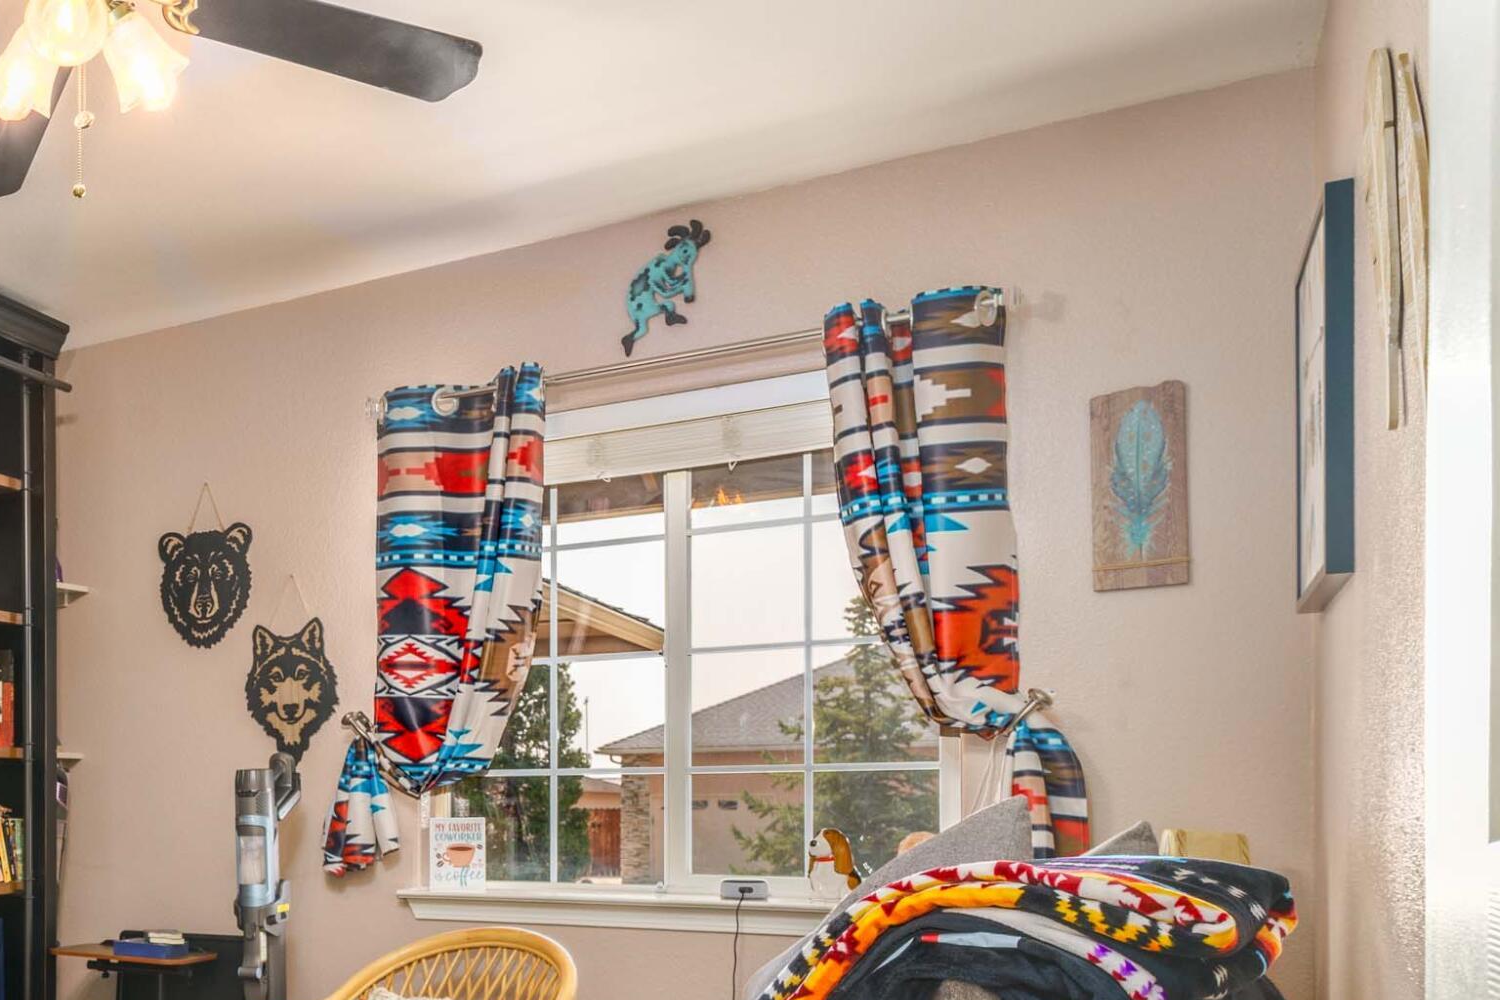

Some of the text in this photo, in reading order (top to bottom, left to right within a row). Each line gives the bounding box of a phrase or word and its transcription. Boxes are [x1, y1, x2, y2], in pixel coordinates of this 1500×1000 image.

[435, 822, 481, 832] MY FAVORITE
[434, 832, 482, 841] COWORKER
